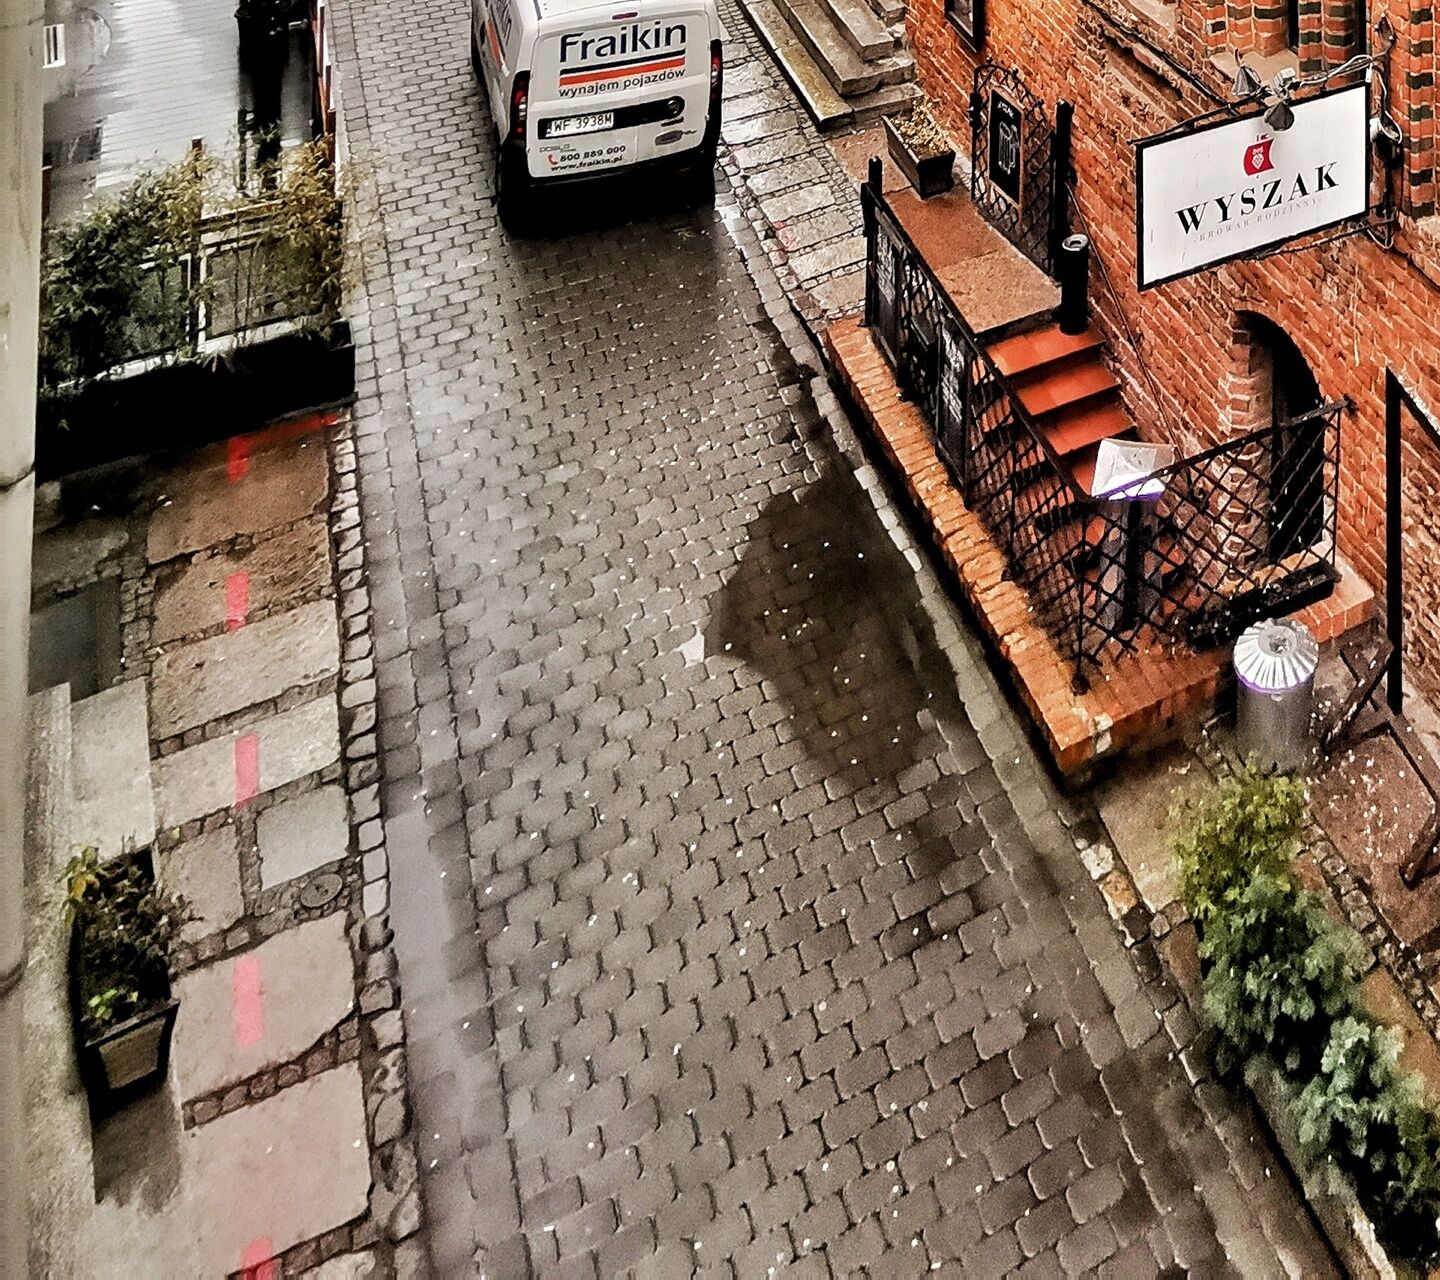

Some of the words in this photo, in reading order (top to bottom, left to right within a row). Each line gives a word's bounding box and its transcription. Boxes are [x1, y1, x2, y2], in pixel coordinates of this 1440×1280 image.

[560, 21, 687, 63] Fraikin
[558, 80, 619, 99] wynajem
[623, 69, 686, 91] pojazdów
[554, 119, 571, 132] WF
[551, 155, 623, 171] www.fraikin.pl
[560, 153, 580, 162] 800
[606, 145, 626, 155] 000
[1174, 161, 1339, 235] WYSZAK
